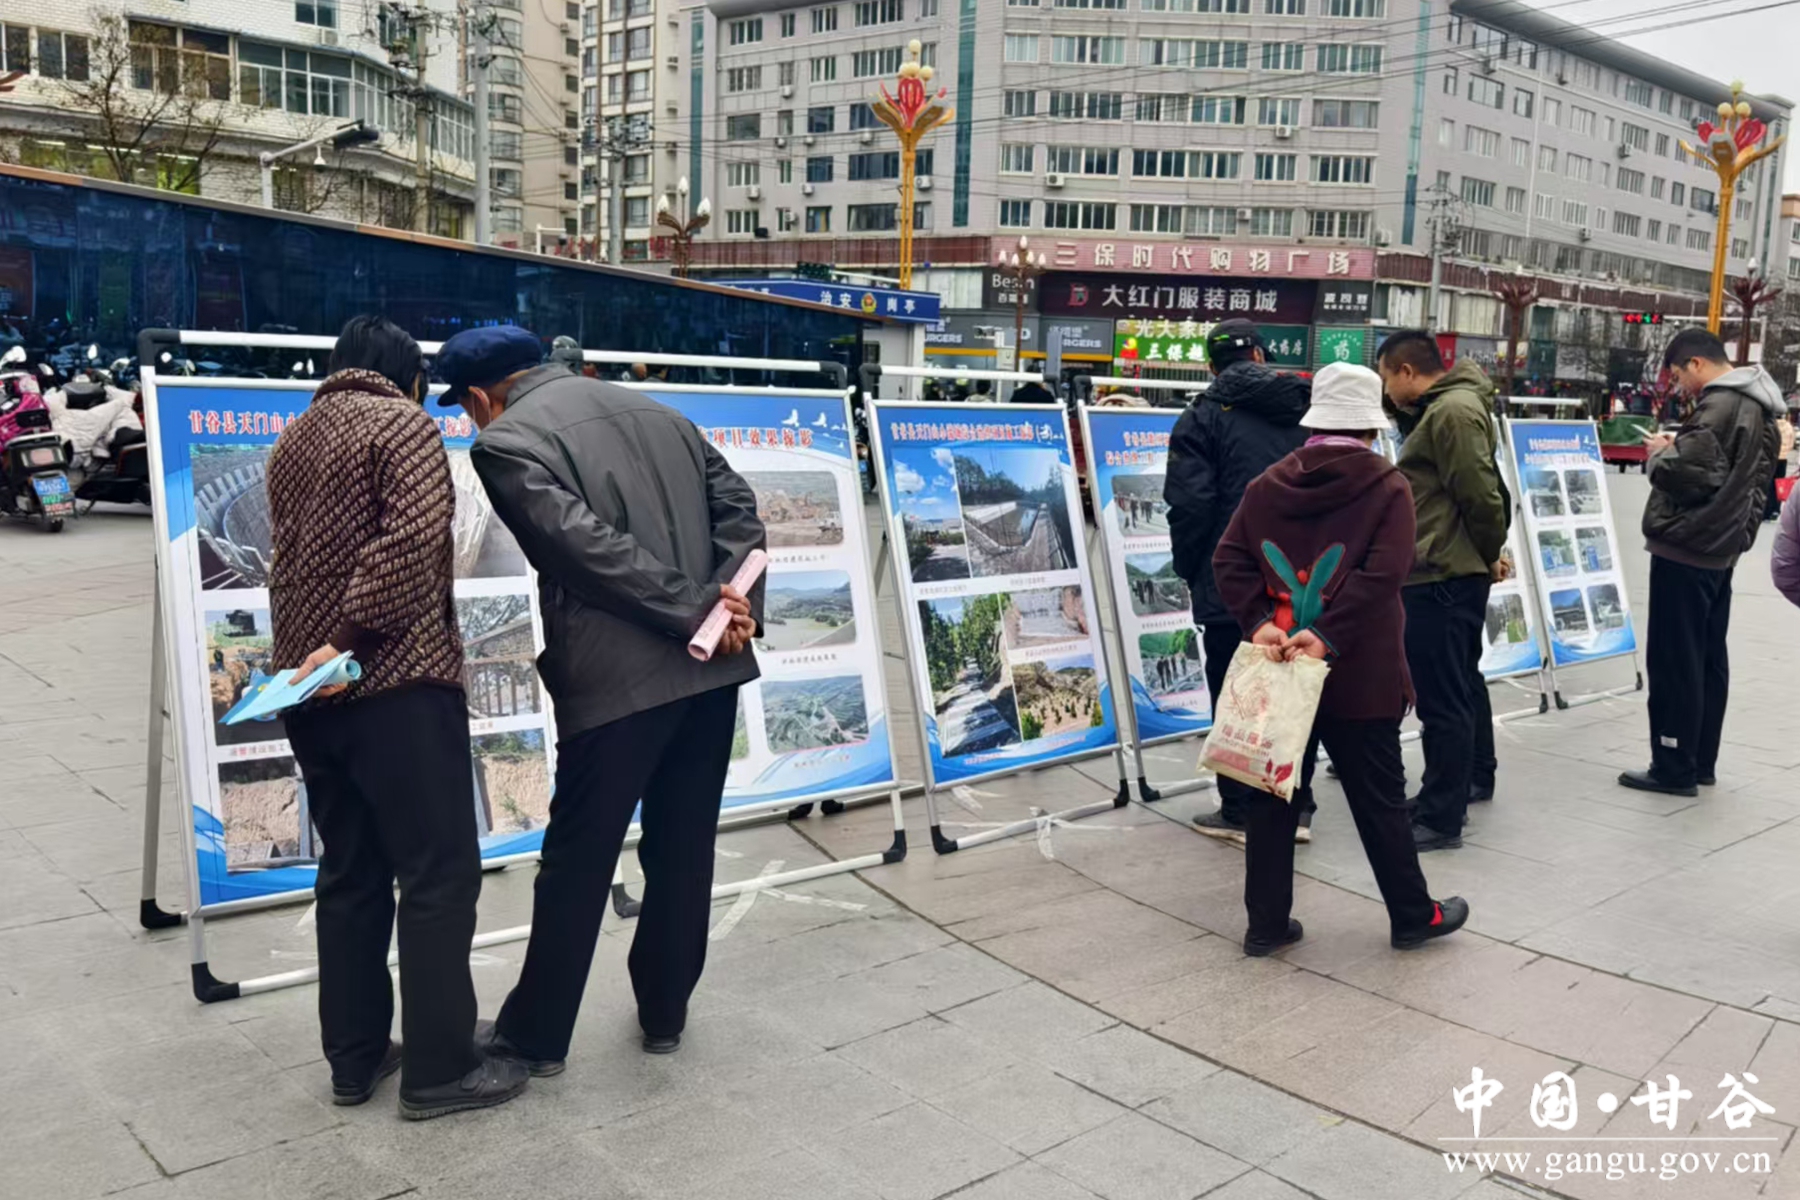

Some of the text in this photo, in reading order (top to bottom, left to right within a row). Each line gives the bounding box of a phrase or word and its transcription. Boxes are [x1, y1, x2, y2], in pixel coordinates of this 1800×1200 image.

[1054, 241, 1350, 275] 三保时代购物广场
[820, 290, 916, 314] 治安 岗亭
[1101, 284, 1278, 313] 大红门服装商城
[1333, 339, 1350, 361] 药
